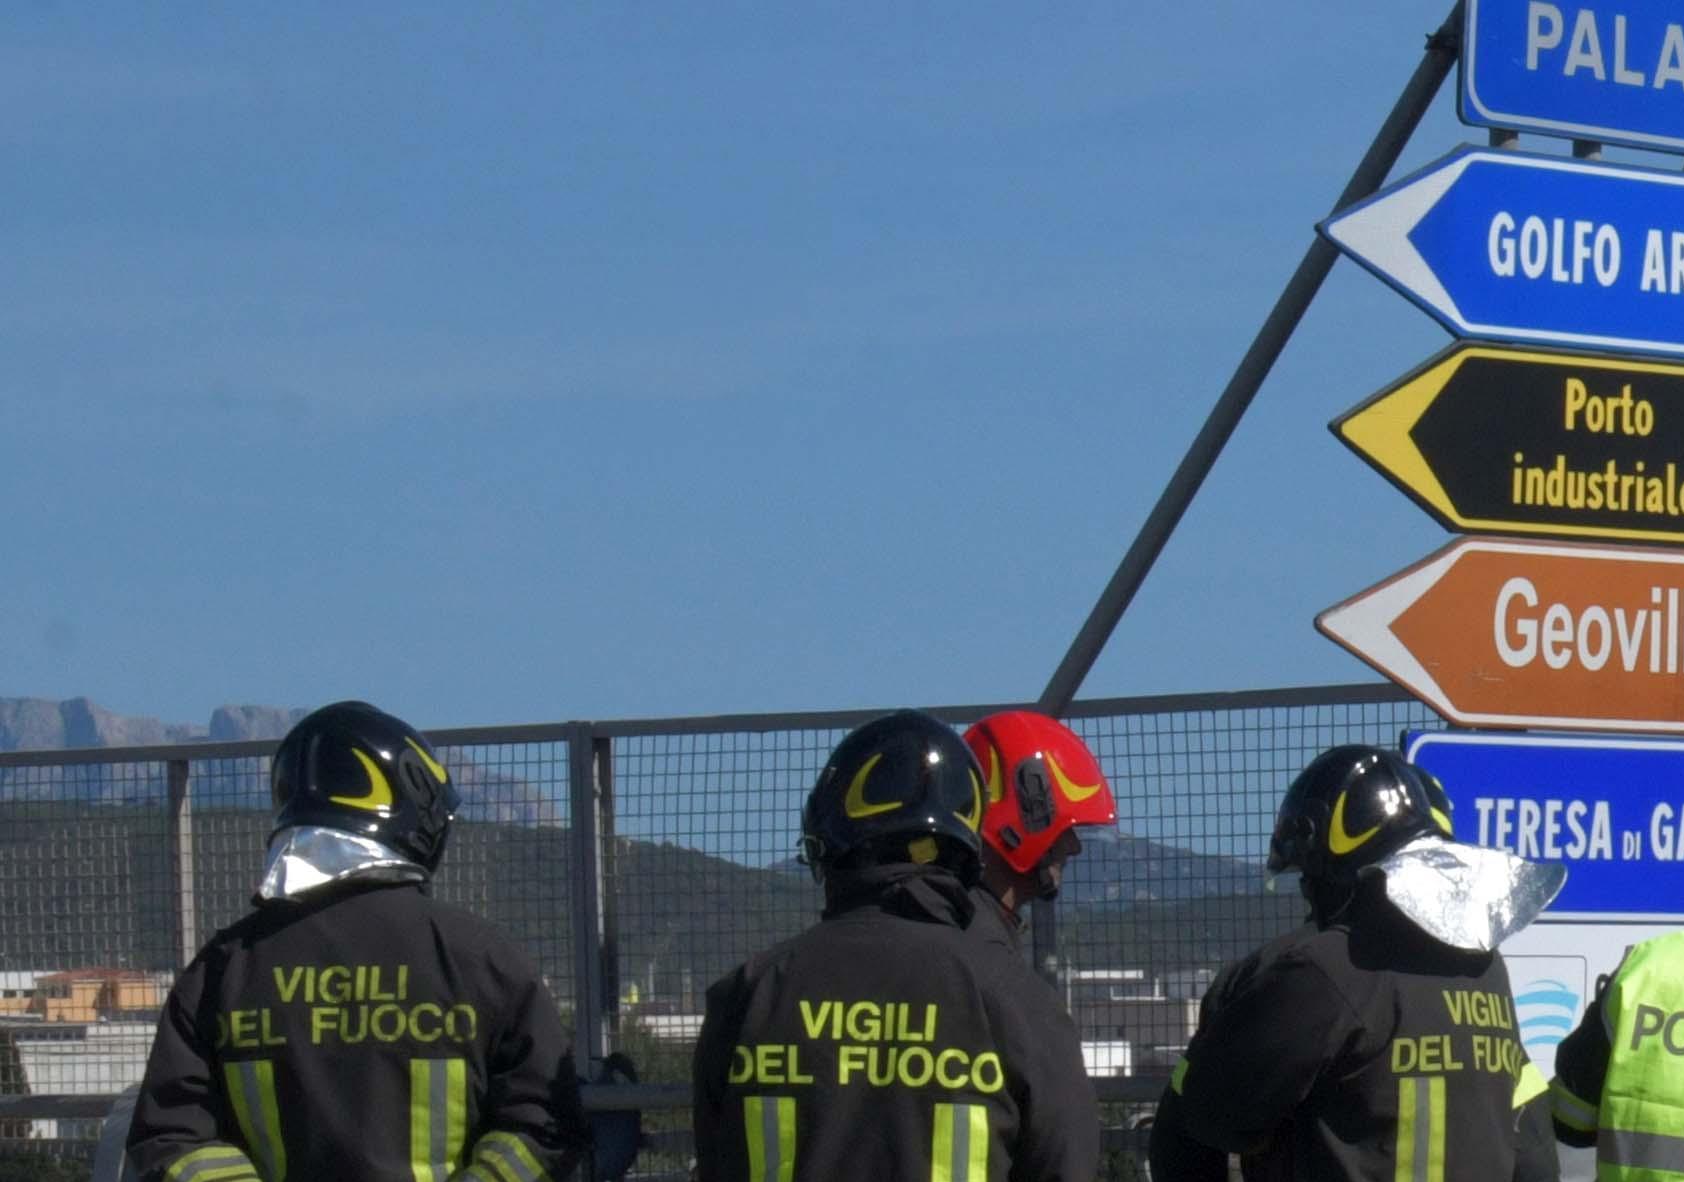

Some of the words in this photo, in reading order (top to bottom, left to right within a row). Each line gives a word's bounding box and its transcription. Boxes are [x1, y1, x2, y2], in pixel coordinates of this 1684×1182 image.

[1487, 211, 1621, 287] GOLFO
[1565, 377, 1654, 436] Porto
[1475, 798, 1613, 860] TERESA
[273, 965, 408, 1002] VIGILI
[311, 1003, 477, 1044] FUOCO
[800, 1001, 937, 1042] VIGILI
[1442, 990, 1512, 1030] VIGILI
[728, 1045, 813, 1084] DEL
[838, 1046, 1004, 1093] FUOCO
[1391, 1035, 1464, 1073] DEL
